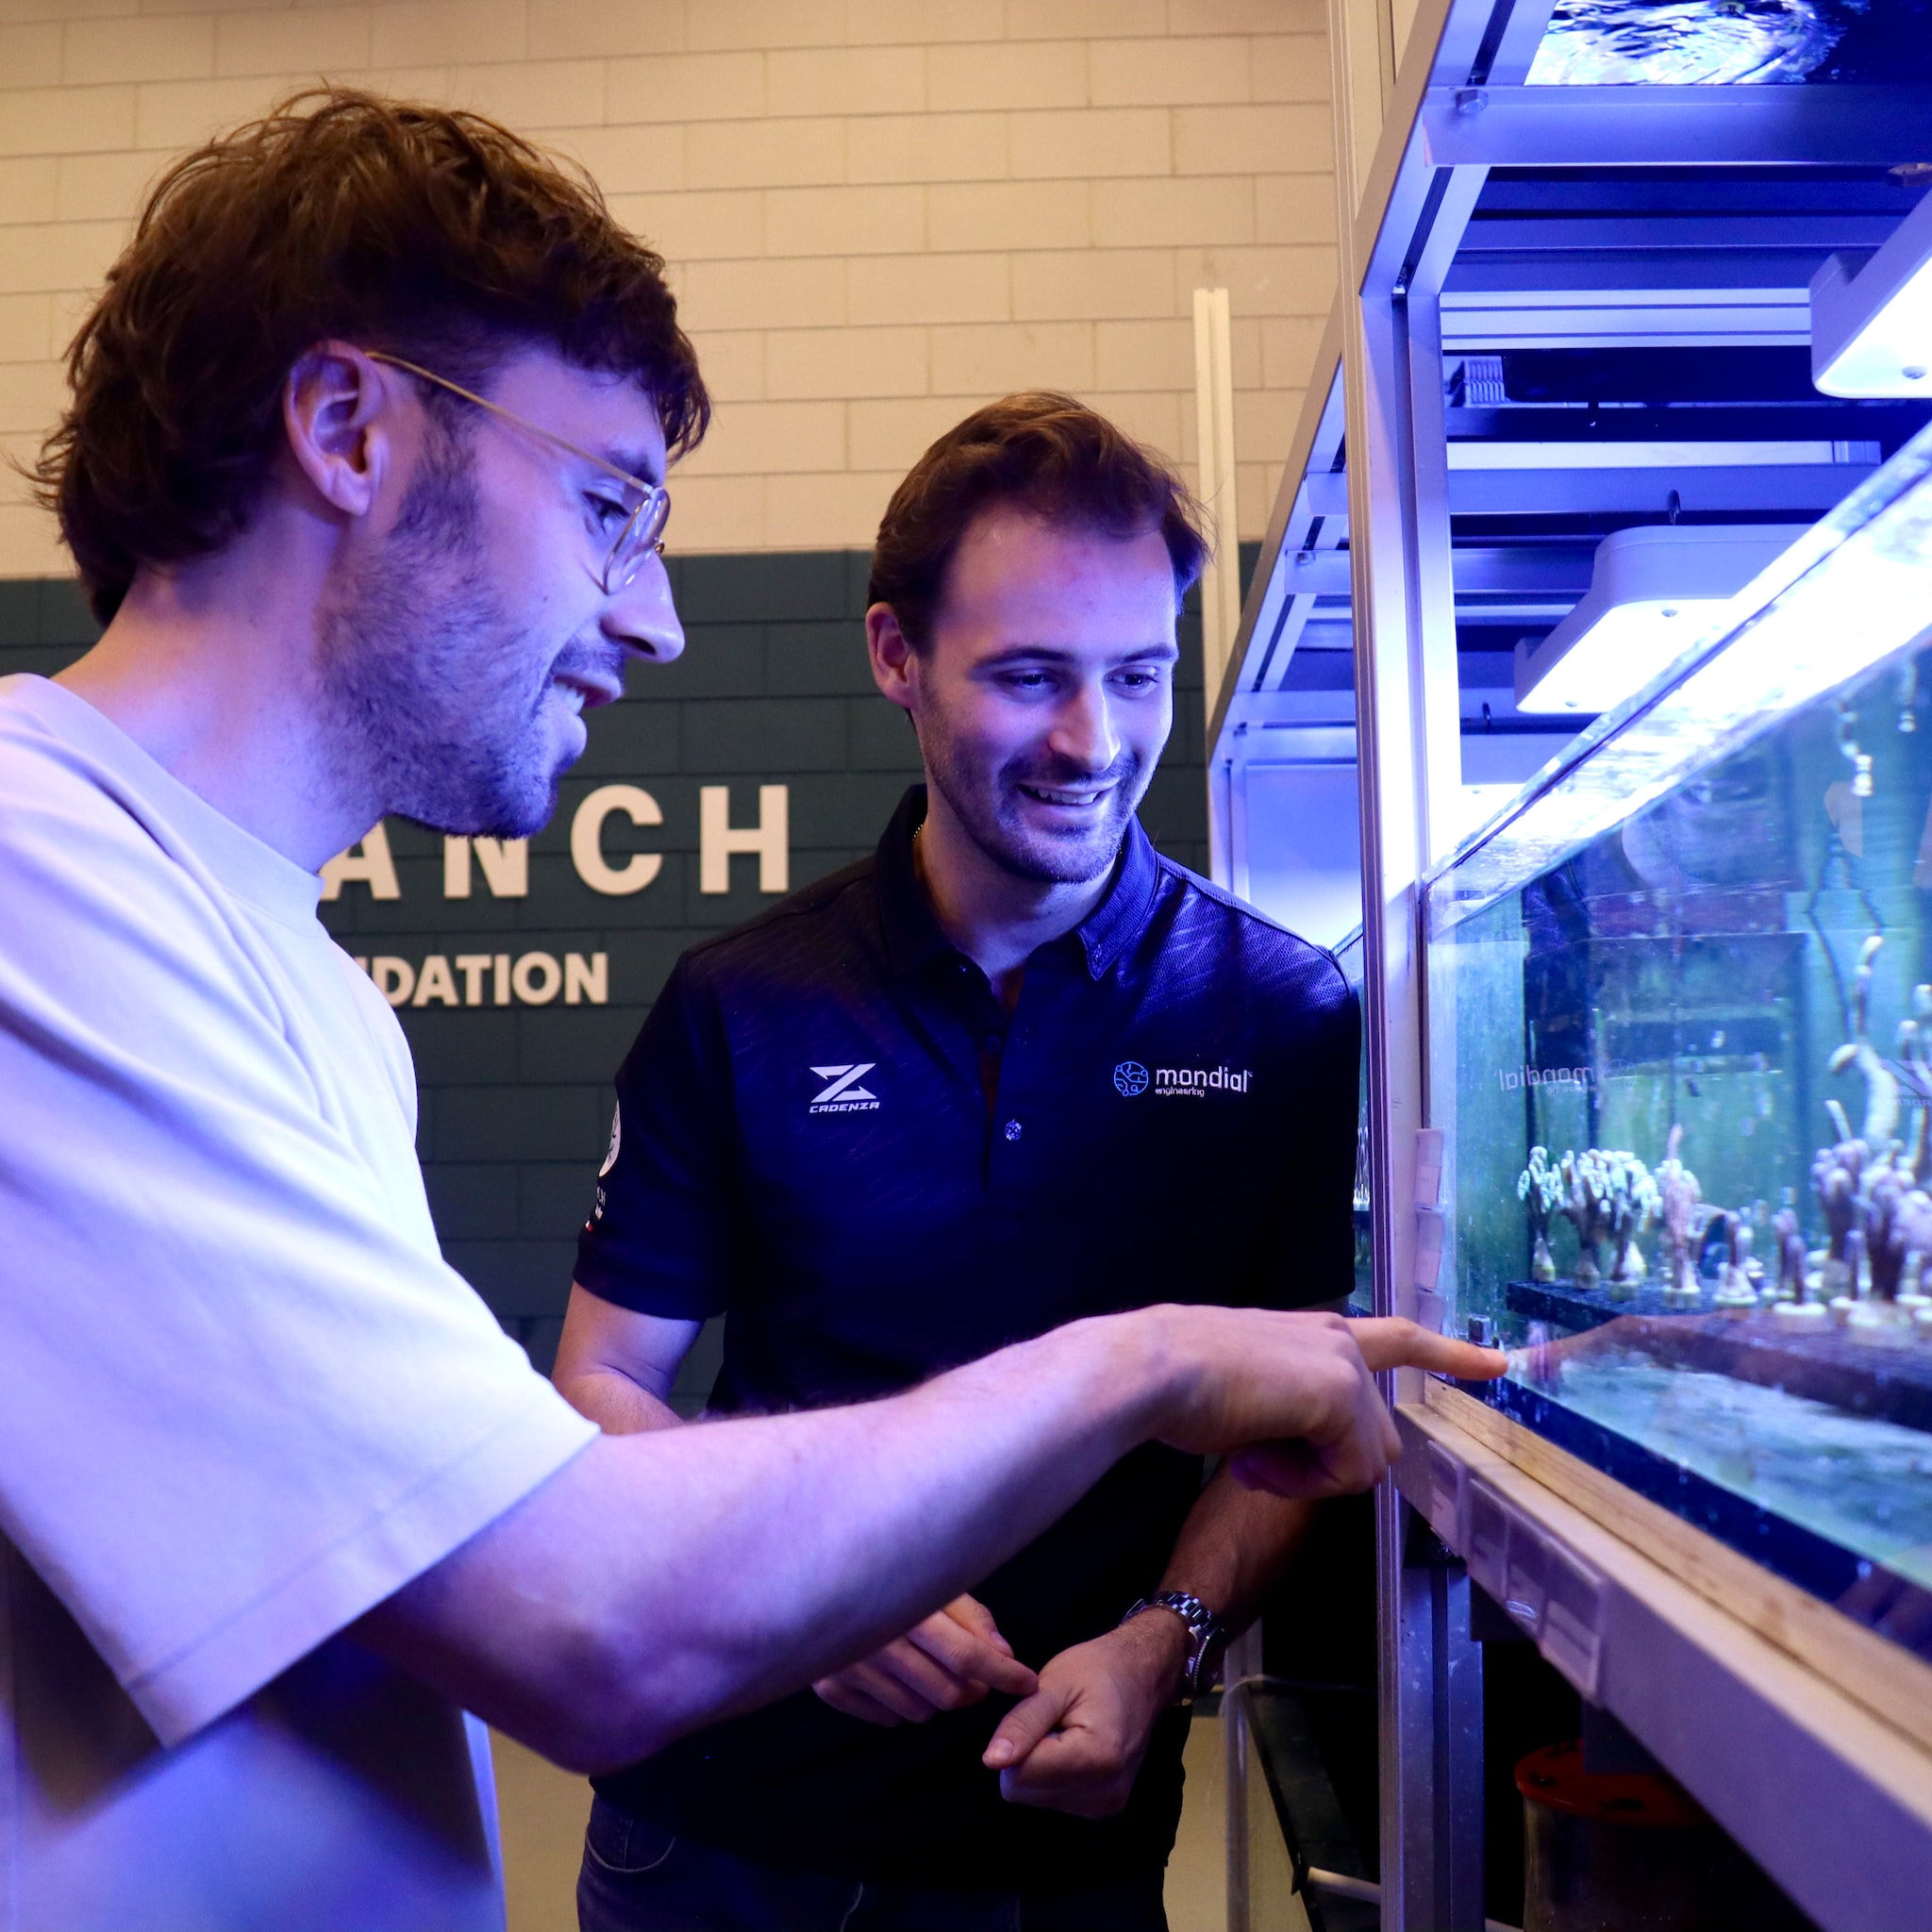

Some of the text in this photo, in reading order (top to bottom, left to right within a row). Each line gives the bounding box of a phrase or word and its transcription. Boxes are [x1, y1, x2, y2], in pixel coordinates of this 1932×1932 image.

[353, 951, 608, 1007] DATION
[1156, 1066, 1248, 1092] mondial
[1155, 1086, 1205, 1097] engineering
[808, 1101, 880, 1113] CADENZA
